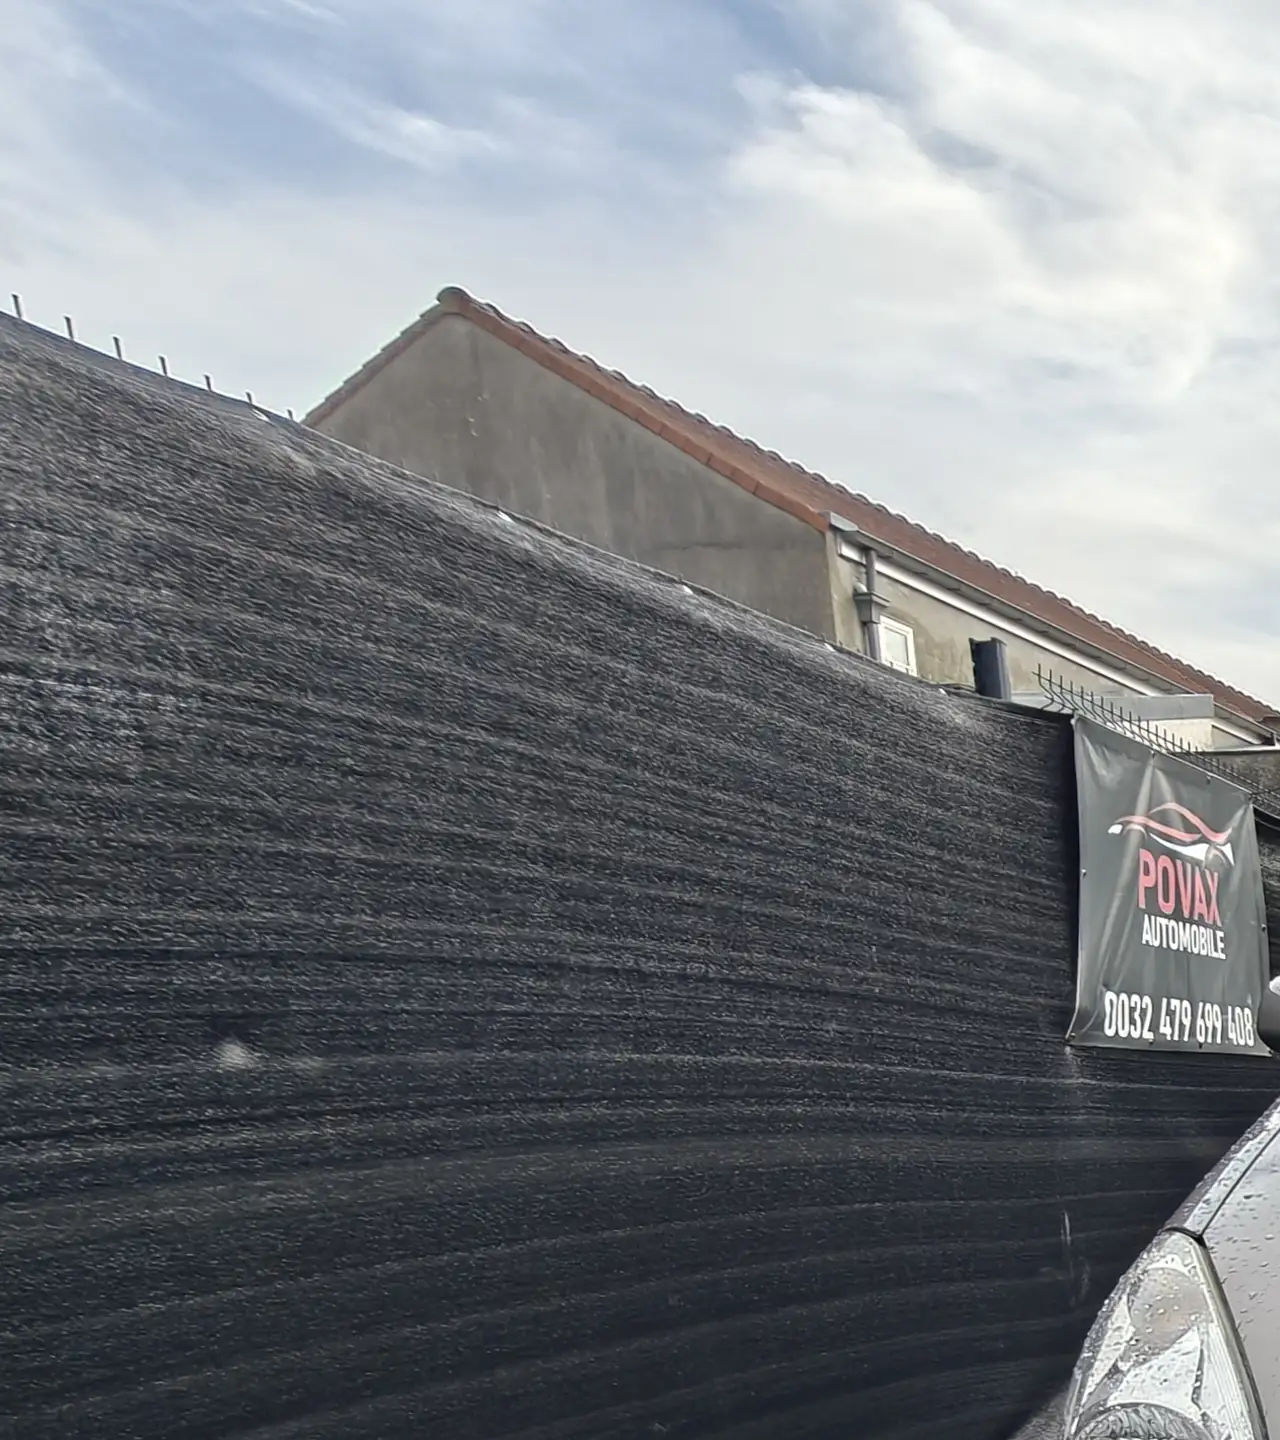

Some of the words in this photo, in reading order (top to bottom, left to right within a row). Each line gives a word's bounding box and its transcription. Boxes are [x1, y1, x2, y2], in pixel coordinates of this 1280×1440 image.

[1137, 848, 1222, 927] POVAX
[1141, 913, 1226, 960] AUTOMOBILE
[1103, 990, 1154, 1040] 0032
[1159, 997, 1192, 1042] 479
[1196, 1001, 1222, 1044] 699
[1227, 1005, 1254, 1046] 408
